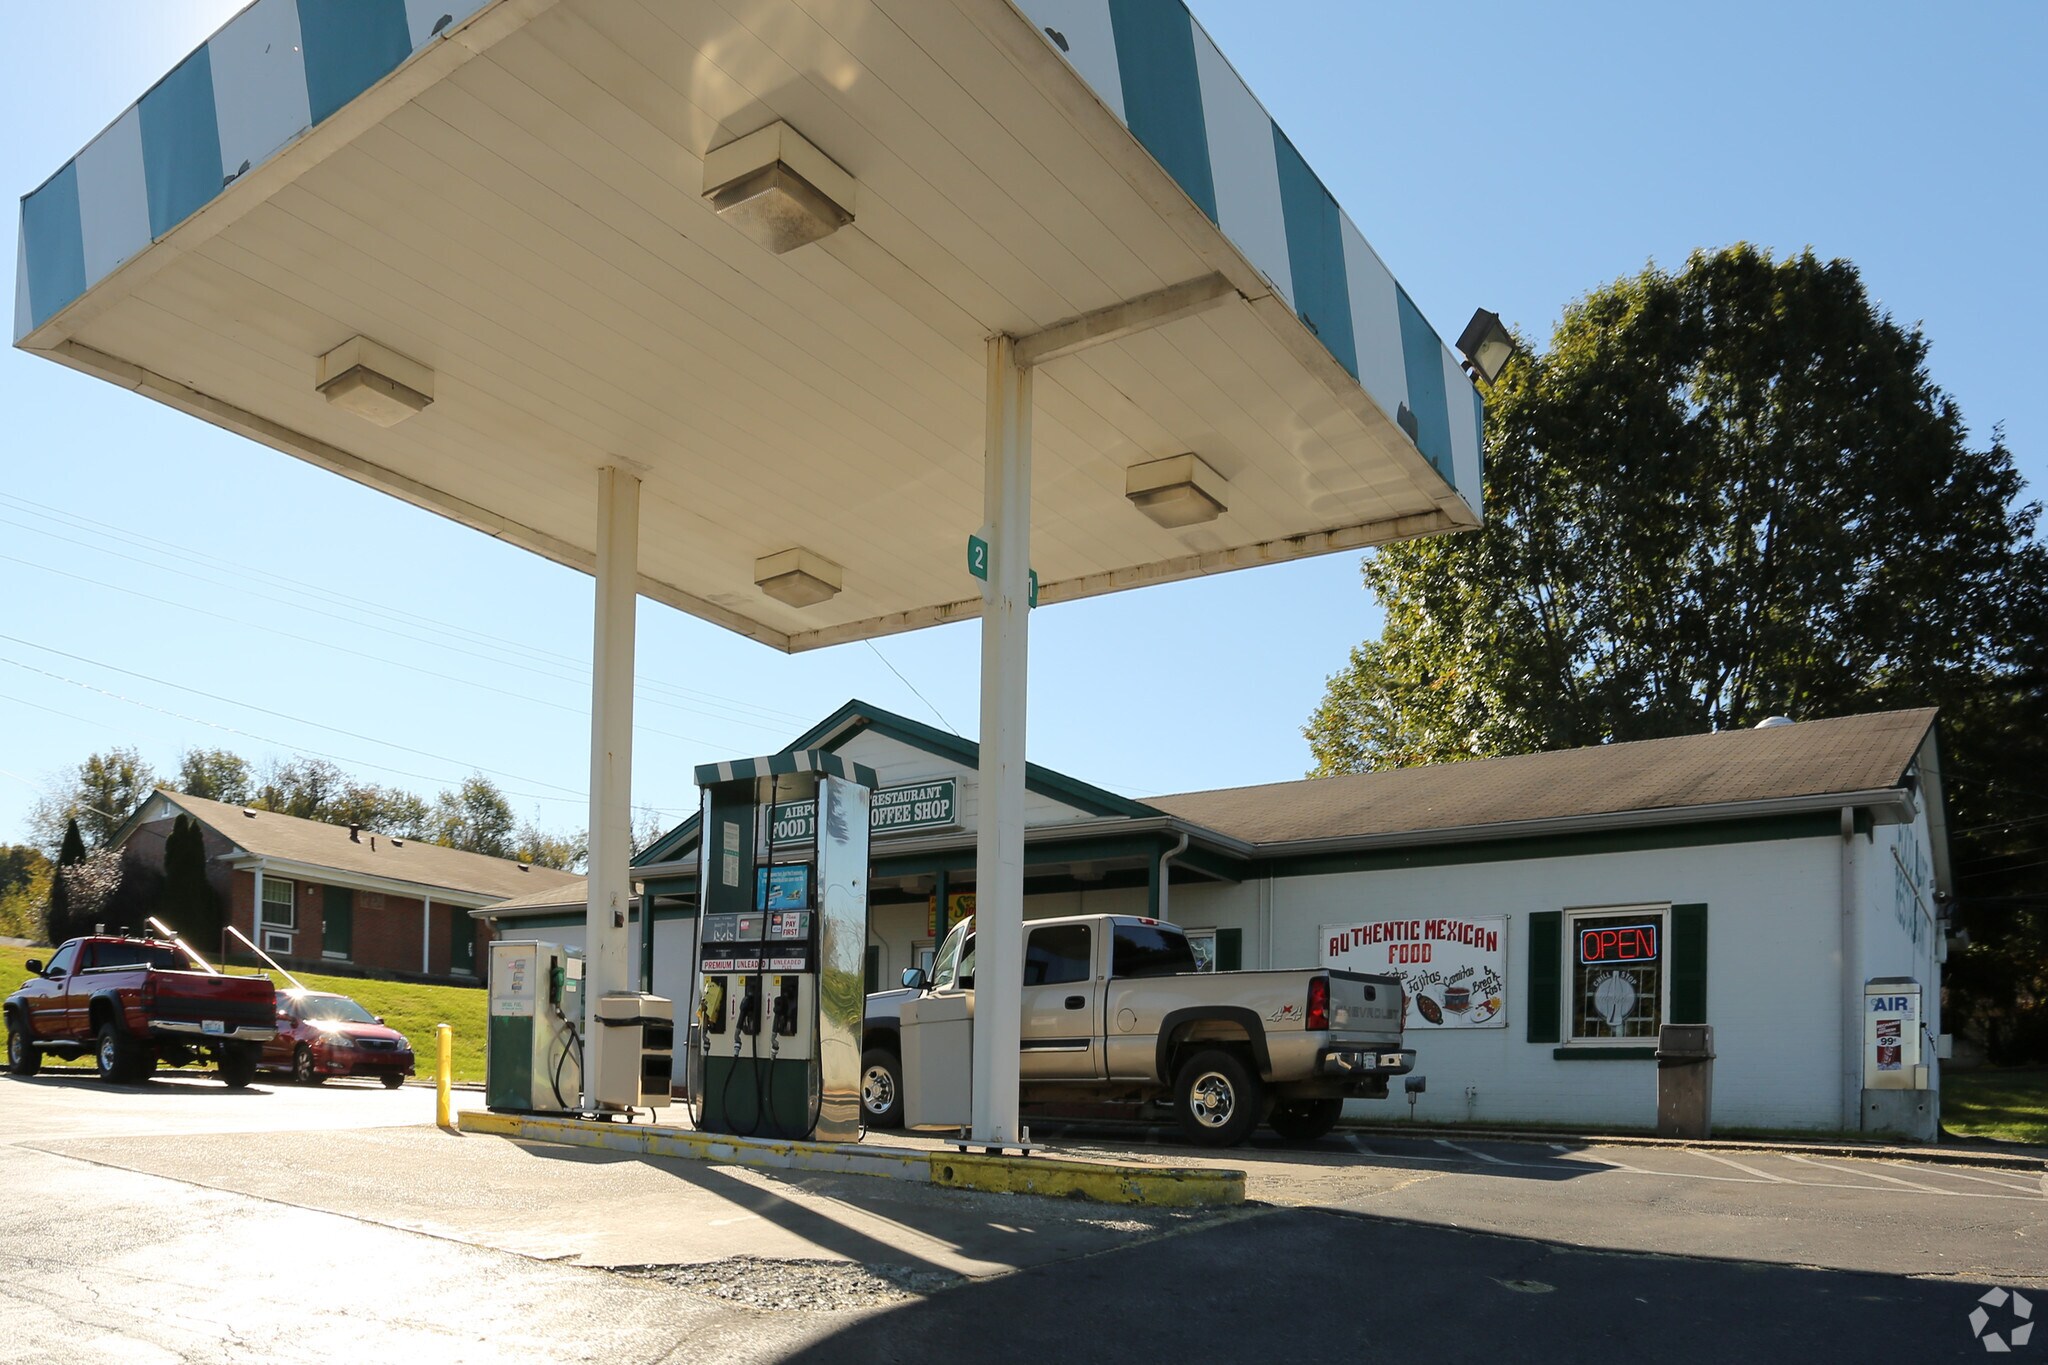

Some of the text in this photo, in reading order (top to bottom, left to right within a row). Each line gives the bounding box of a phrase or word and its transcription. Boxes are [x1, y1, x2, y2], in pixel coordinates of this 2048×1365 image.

[975, 545, 984, 570] 2
[1028, 577, 1033, 598] 1
[871, 785, 942, 806] RESTAURANT
[871, 803, 911, 827] OFFEE
[914, 799, 950, 821] SHOP
[785, 920, 797, 928] PAY
[801, 915, 808, 928] 2
[783, 928, 798, 936] FIRST
[1329, 919, 1498, 957] AUTHENTIC MEXICAN
[1388, 943, 1432, 964] FOOD
[1583, 929, 1655, 961] OPEN
[704, 961, 732, 969] PREMIUM
[736, 960, 766, 969] UNLEADD
[1406, 970, 1442, 994] Fajitas
[1472, 972, 1501, 996] Break
[1593, 971, 1611, 987] CHILL
[1621, 971, 1638, 986] STOP
[1334, 1005, 1400, 1020] CHEVROLET
[1873, 996, 1908, 1012] AIR
